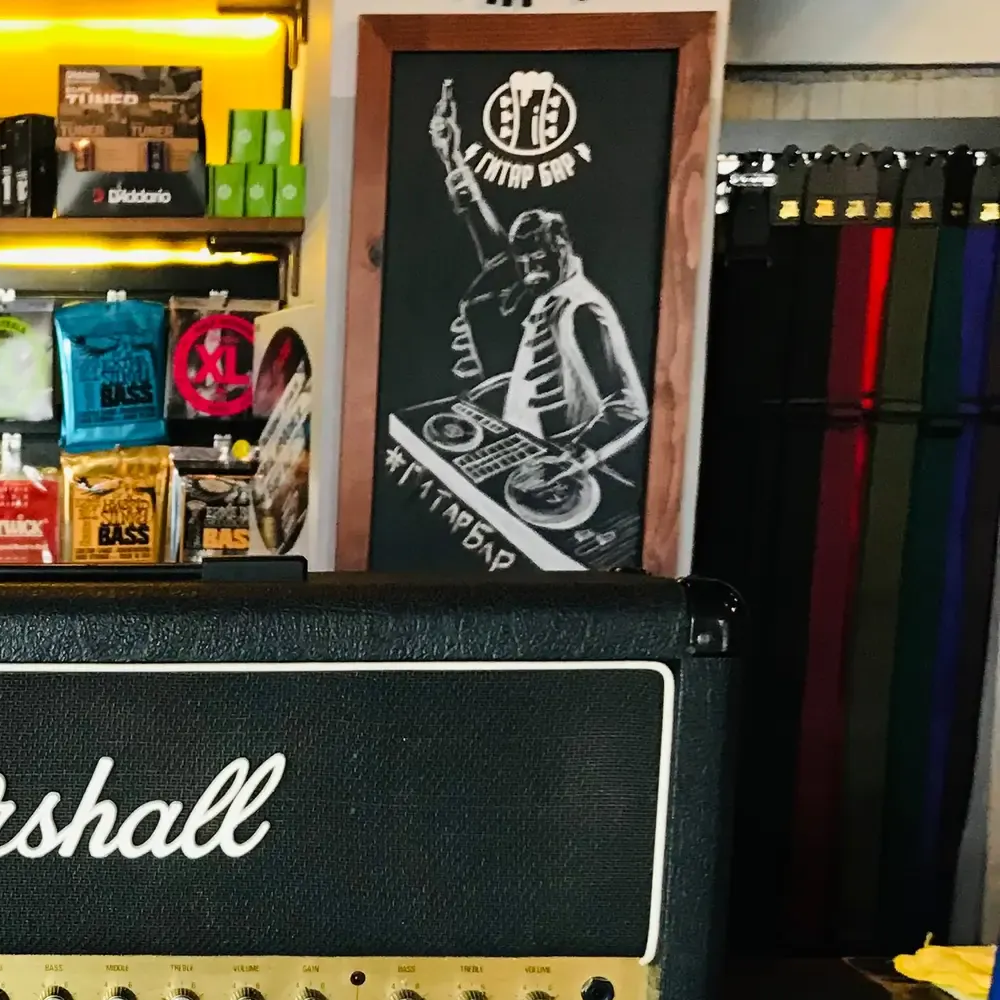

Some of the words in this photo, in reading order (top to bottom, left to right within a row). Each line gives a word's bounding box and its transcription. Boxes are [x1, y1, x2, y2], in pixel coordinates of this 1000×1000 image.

[474, 152, 534, 189] ГИТАР
[538, 152, 576, 188] БАР
[196, 344, 251, 385] XL
[98, 523, 149, 546] BASS
[170, 964, 193, 972] TREBLE
